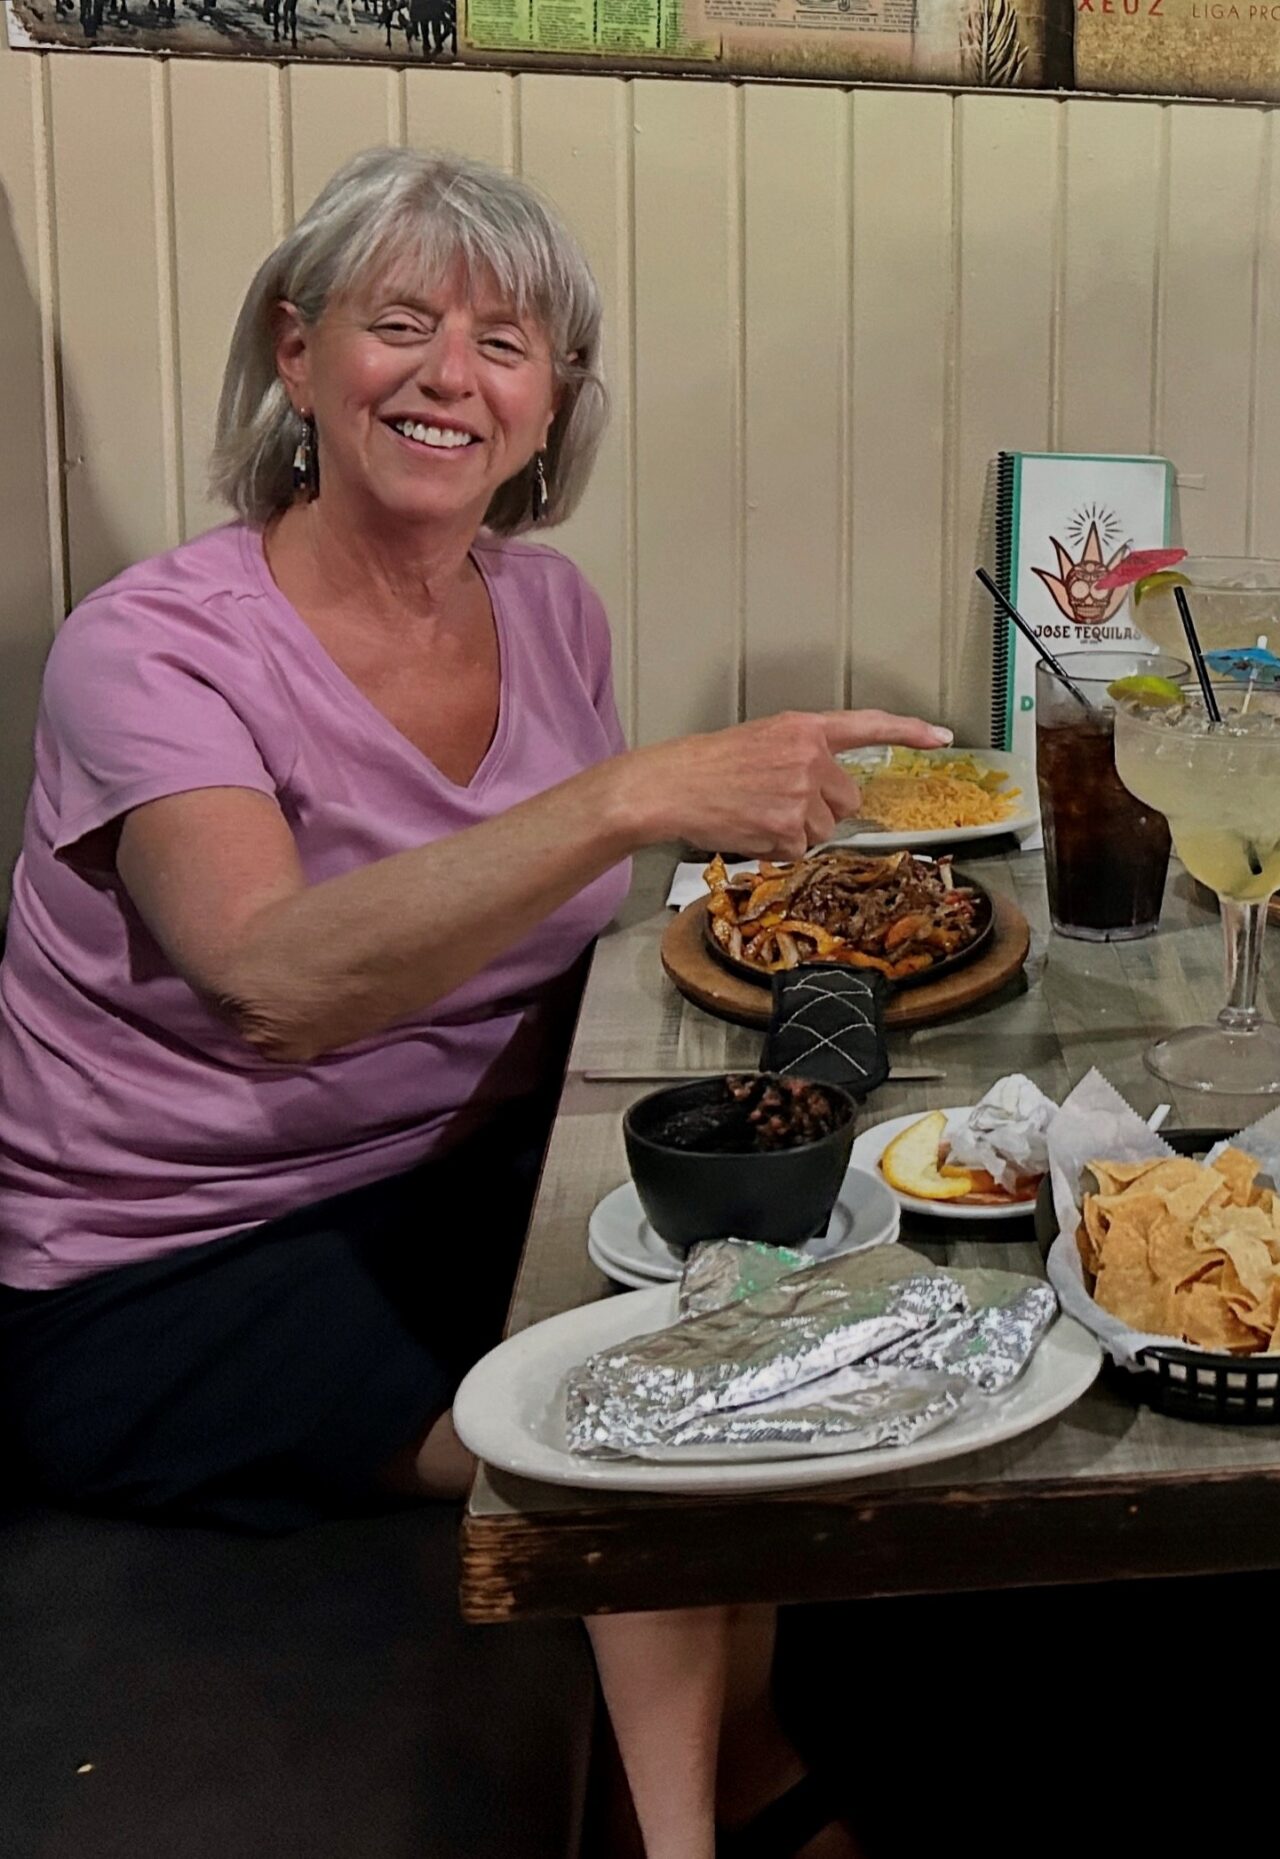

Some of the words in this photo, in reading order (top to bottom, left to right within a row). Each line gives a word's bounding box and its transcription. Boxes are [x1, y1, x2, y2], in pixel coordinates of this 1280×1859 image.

[1192, 4, 1240, 20] LIGA
[1034, 625, 1070, 638] JOSE
[1075, 625, 1142, 642] TEQUILAS
